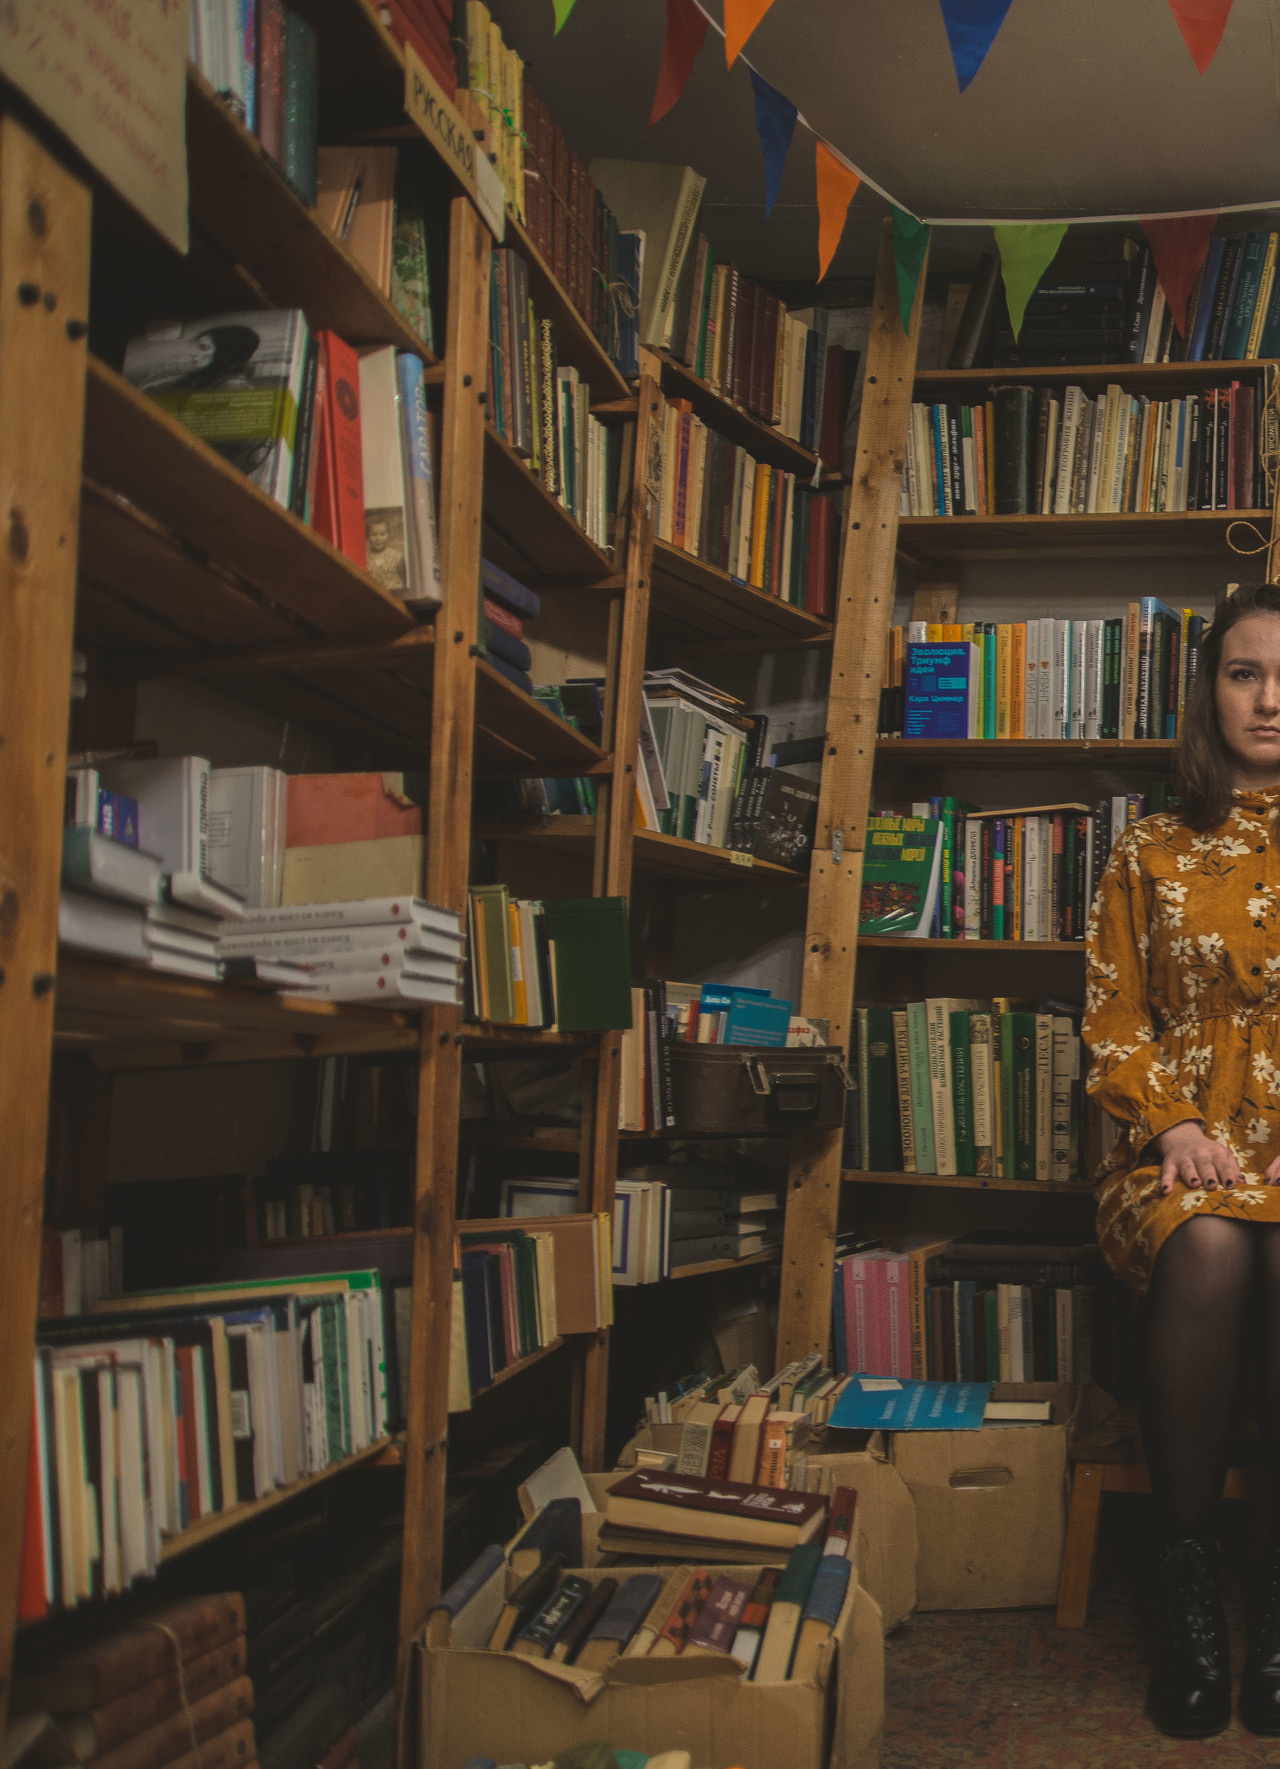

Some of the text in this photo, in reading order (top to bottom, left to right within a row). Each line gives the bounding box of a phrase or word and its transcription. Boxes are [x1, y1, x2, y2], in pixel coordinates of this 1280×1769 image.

[1060, 391, 1076, 472] ГЕОГРАФИЯ ЖИЗНИ
[1114, 442, 1124, 475] ДРУЗЬЯМ
[1112, 477, 1120, 504] СОВЕТЫ
[911, 648, 967, 656] Эволюция.
[911, 656, 952, 666] Триумф
[1040, 671, 1050, 703] КВАНТ
[1128, 656, 1136, 685] ХОКИНГ
[1027, 672, 1037, 705] КВАНТ
[1126, 686, 1134, 715] СТИВЕН
[935, 1005, 948, 1088] КОМНАТНЫХ РАСТЕНИЙ
[1037, 1034, 1049, 1073] ЛЕСА
[896, 1030, 913, 1152] ЗООЛОГИЯ ДЛЯ УЧИТЕЛЯ
[935, 1090, 947, 1159] ИЛЛЮСТРИРОВАННАЯ
